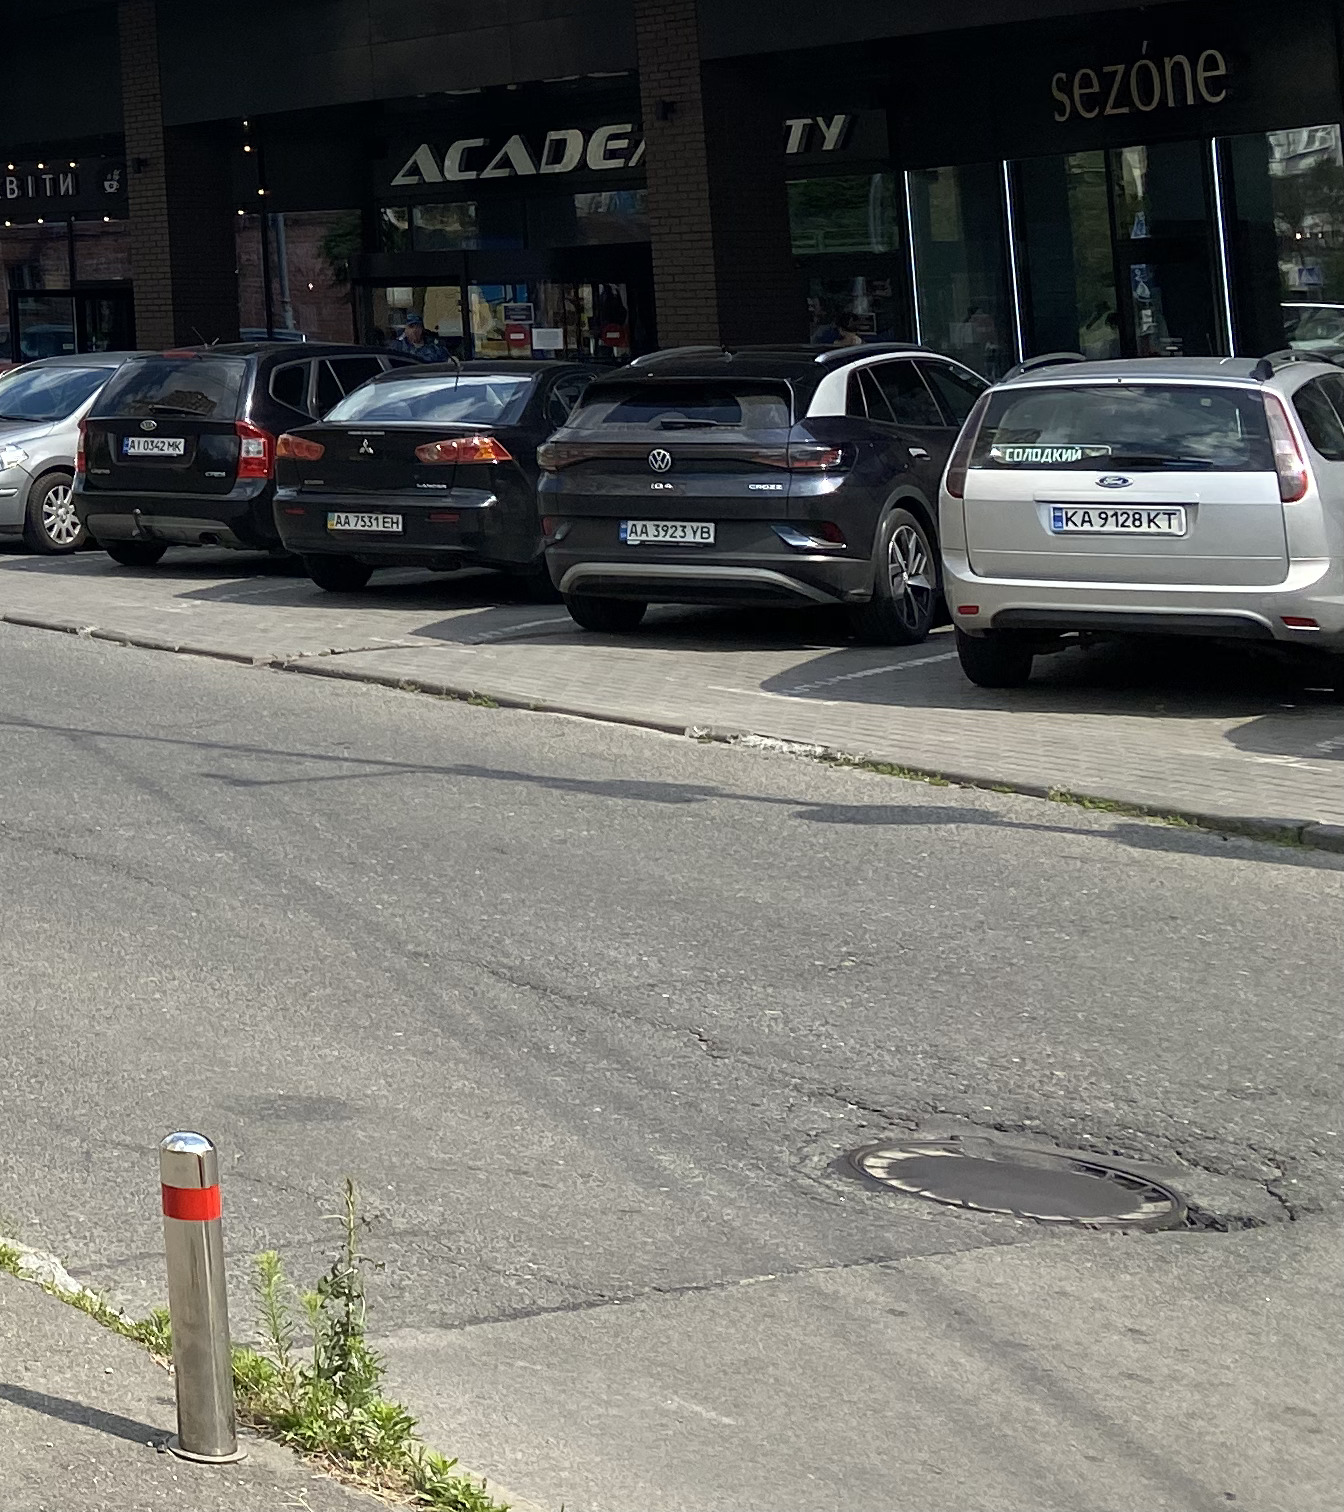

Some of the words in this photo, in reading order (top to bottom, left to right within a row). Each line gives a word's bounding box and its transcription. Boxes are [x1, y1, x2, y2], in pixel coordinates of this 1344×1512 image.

[1052, 40, 1227, 122] sezóne
[784, 114, 846, 154] TY
[129, 439, 141, 450] AI
[143, 440, 166, 452] 0342
[167, 440, 182, 452] MK
[1005, 446, 1082, 463] СОЛОДКИЙ
[335, 514, 351, 528] AA
[353, 514, 380, 529] 7531
[382, 516, 400, 529] EH
[1065, 511, 1093, 529] KA
[1098, 511, 1143, 529] 9128
[1147, 512, 1177, 530] KT
[628, 523, 650, 538] AA
[652, 524, 687, 539] 3923
[691, 525, 712, 540] YB
